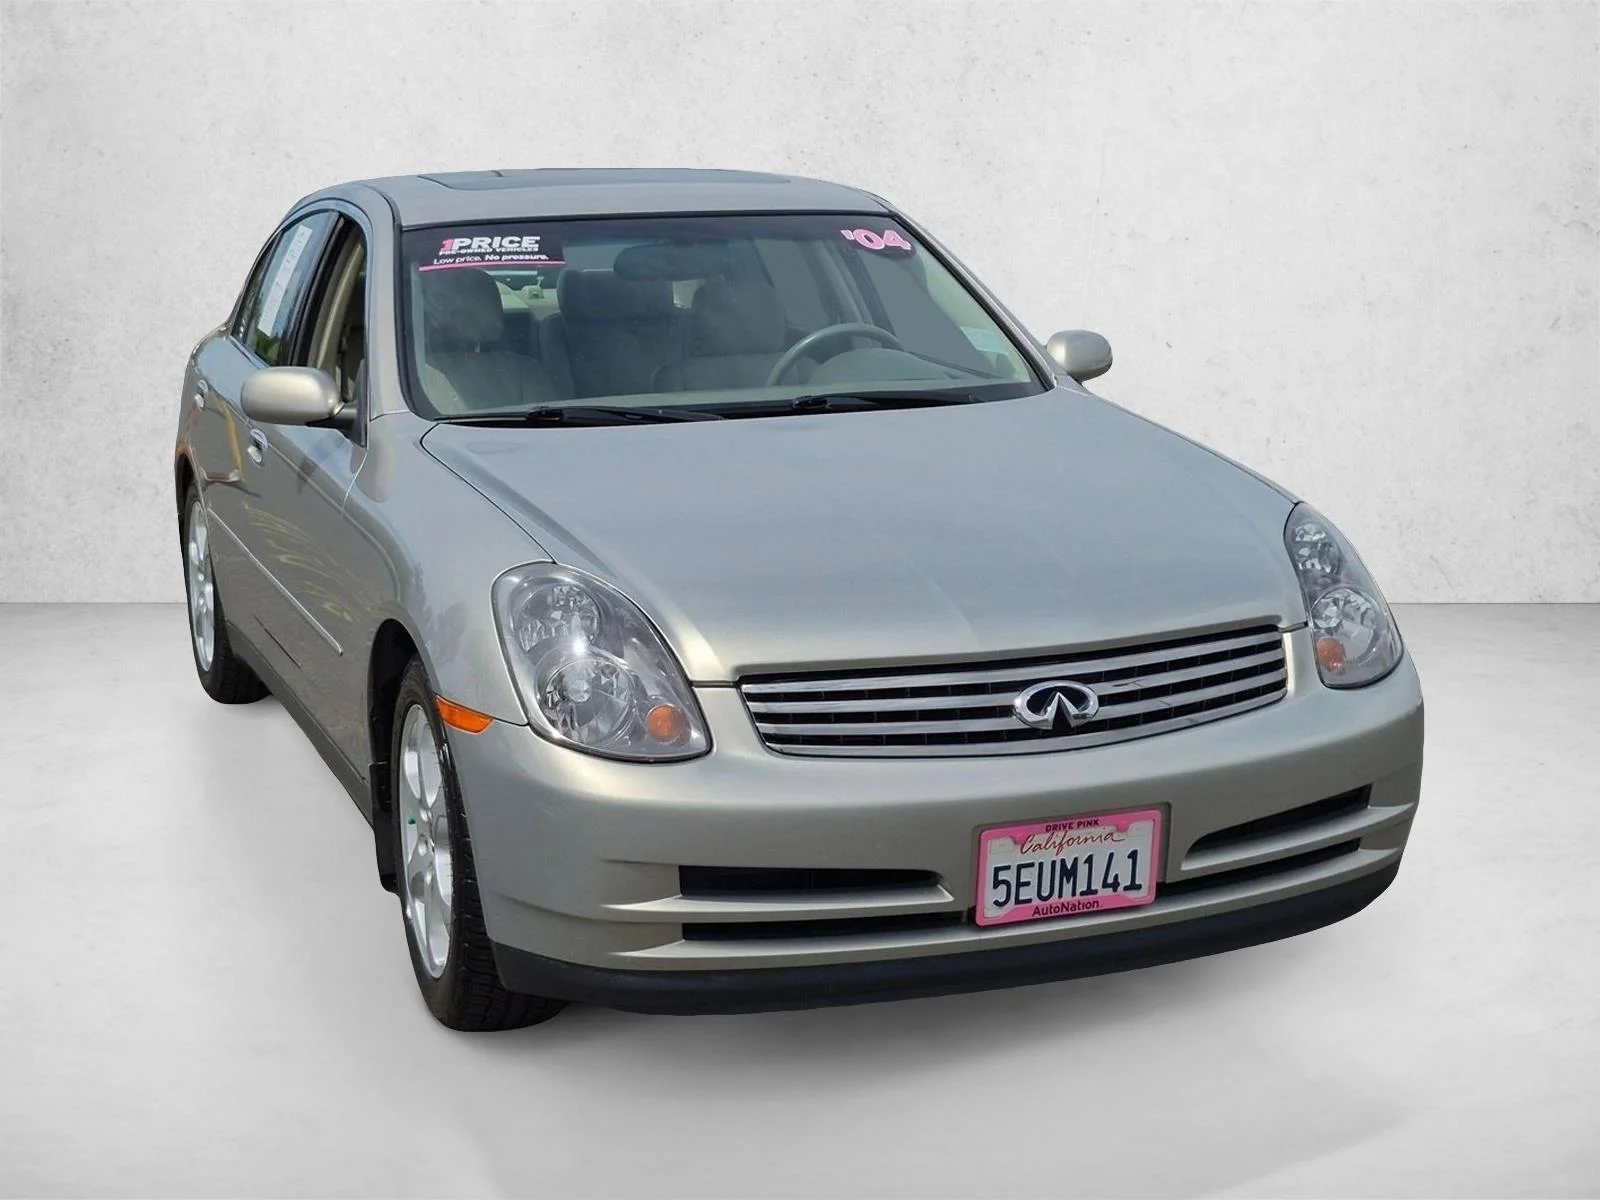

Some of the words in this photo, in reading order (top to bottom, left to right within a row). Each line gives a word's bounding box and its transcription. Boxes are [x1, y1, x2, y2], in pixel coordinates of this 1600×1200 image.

[433, 257, 454, 265] Low
[455, 255, 482, 264] price.
[484, 253, 500, 261] No
[501, 253, 549, 262] pressure.
[438, 247, 493, 256] PRE-OWNED
[1045, 821, 1074, 833] DRIVE
[1076, 818, 1101, 829] PINK
[1020, 830, 1125, 857] California
[992, 848, 1143, 908] 5EUM141
[1031, 899, 1100, 917] AutoNation
